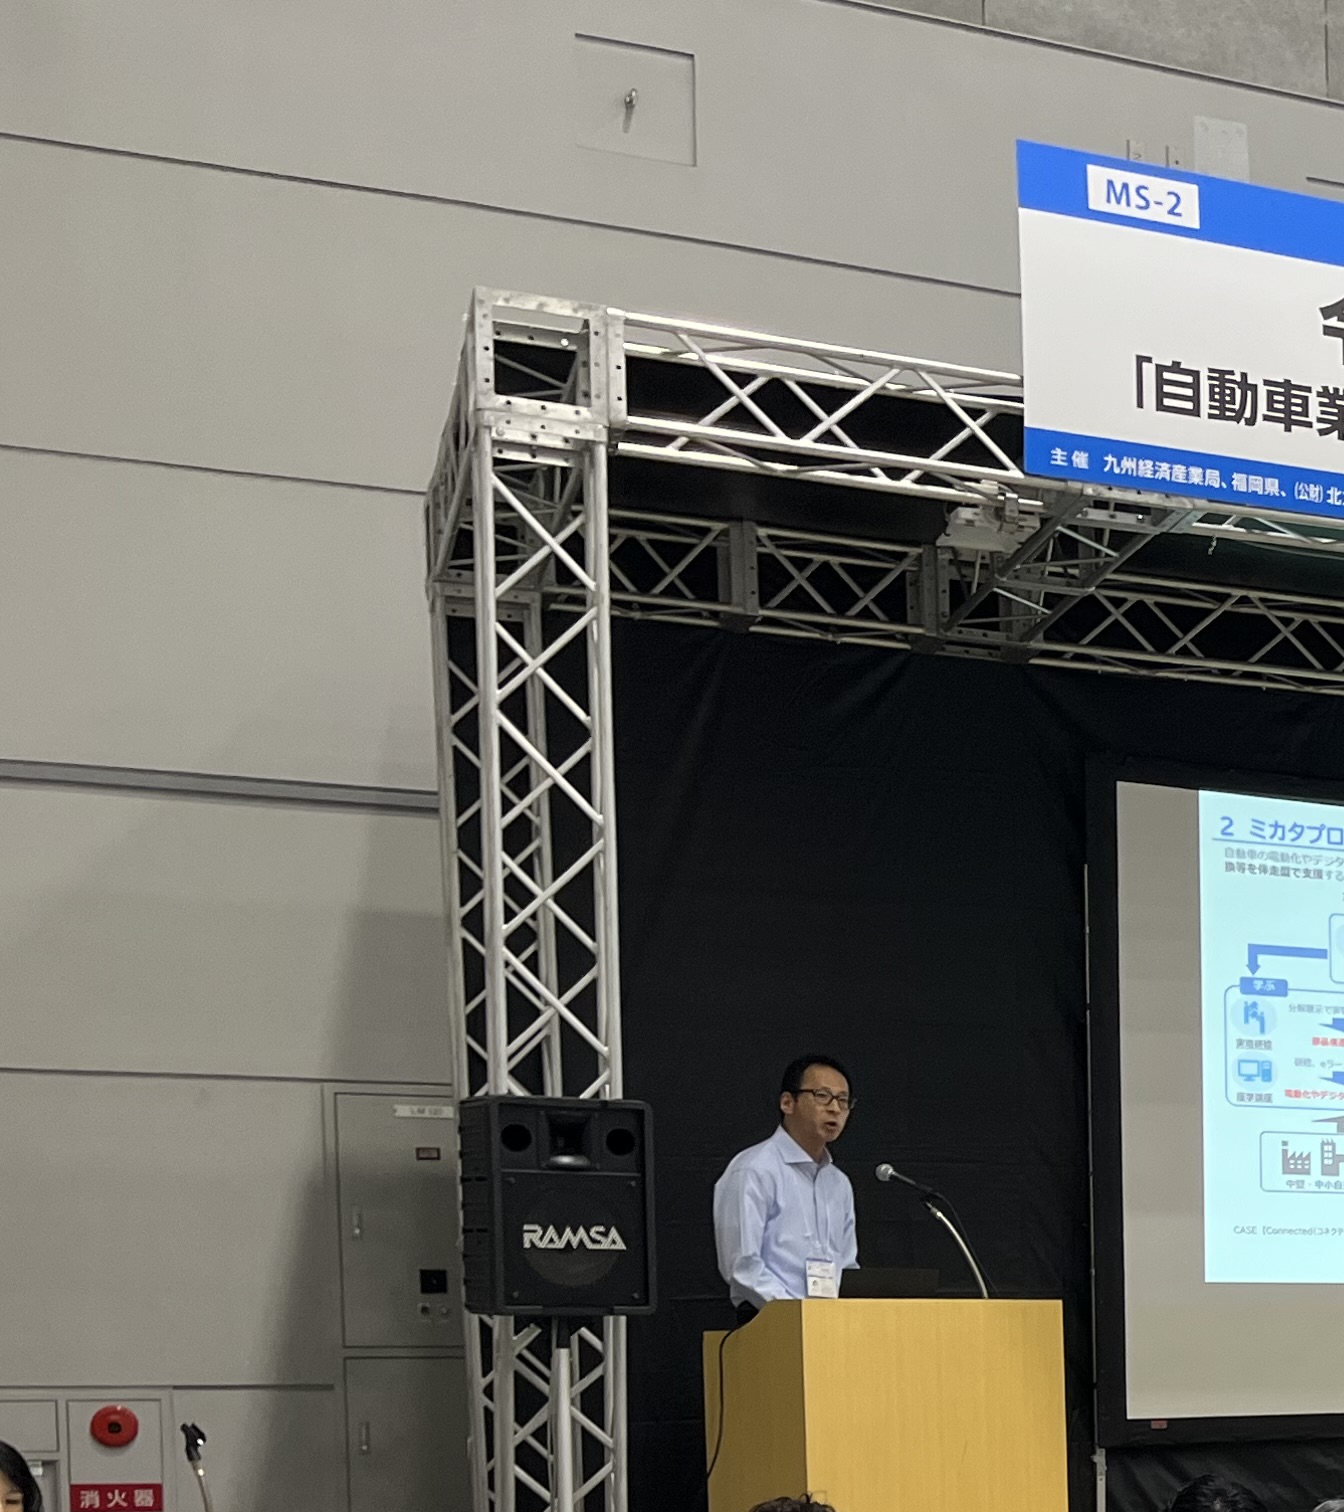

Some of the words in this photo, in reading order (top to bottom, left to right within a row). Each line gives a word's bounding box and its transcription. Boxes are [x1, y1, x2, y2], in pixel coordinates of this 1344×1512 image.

[1105, 179, 1183, 217] MS-2
[1220, 816, 1235, 837] 2
[523, 1224, 627, 1251] RAMSA
[80, 1489, 154, 1509] 消火器
